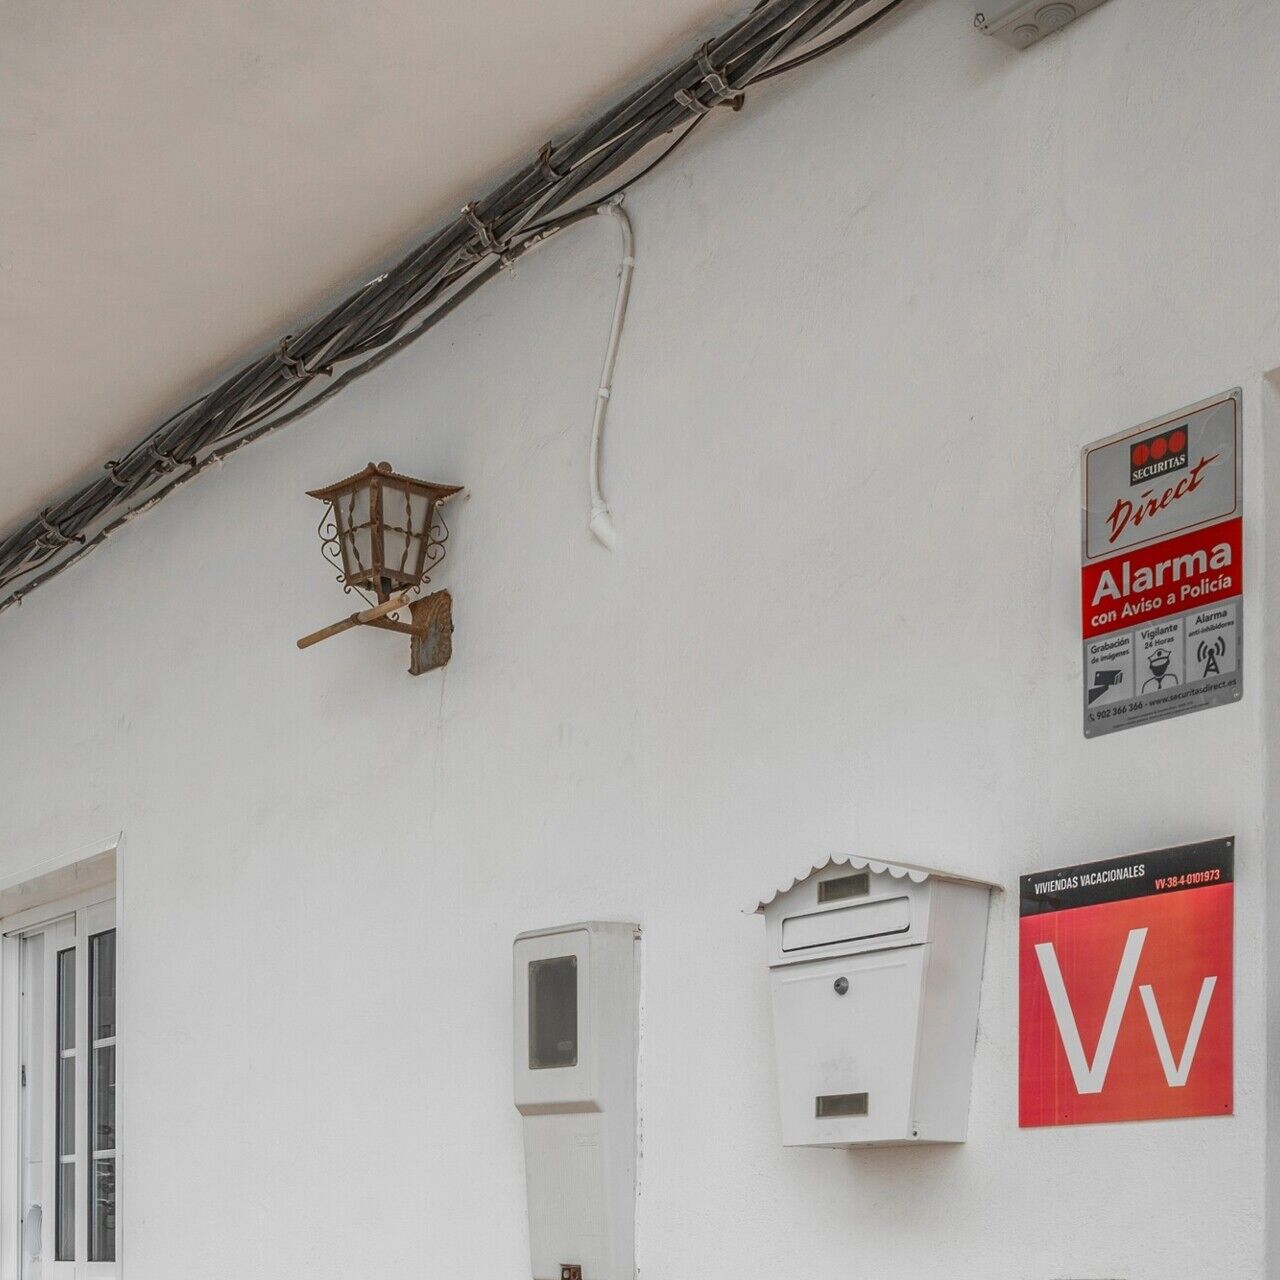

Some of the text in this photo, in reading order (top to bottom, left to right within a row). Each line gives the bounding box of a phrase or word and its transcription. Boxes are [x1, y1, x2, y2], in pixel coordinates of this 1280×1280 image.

[1132, 453, 1186, 482] SECURITAS
[1105, 453, 1220, 544] Direct
[1091, 542, 1232, 607] Alarma
[1091, 574, 1232, 627] con Aviso a Policía
[1195, 609, 1228, 626] Alarma
[1140, 623, 1178, 641] Vigilante
[1090, 637, 1130, 655] Grabación
[1144, 636, 1175, 650] 24 Horas
[1090, 656, 1099, 665] de
[1096, 709, 1111, 721] 902
[1112, 705, 1127, 717] 366
[1128, 702, 1143, 713] 366
[1034, 864, 1145, 895] VIVIENDAS VACACIONALES
